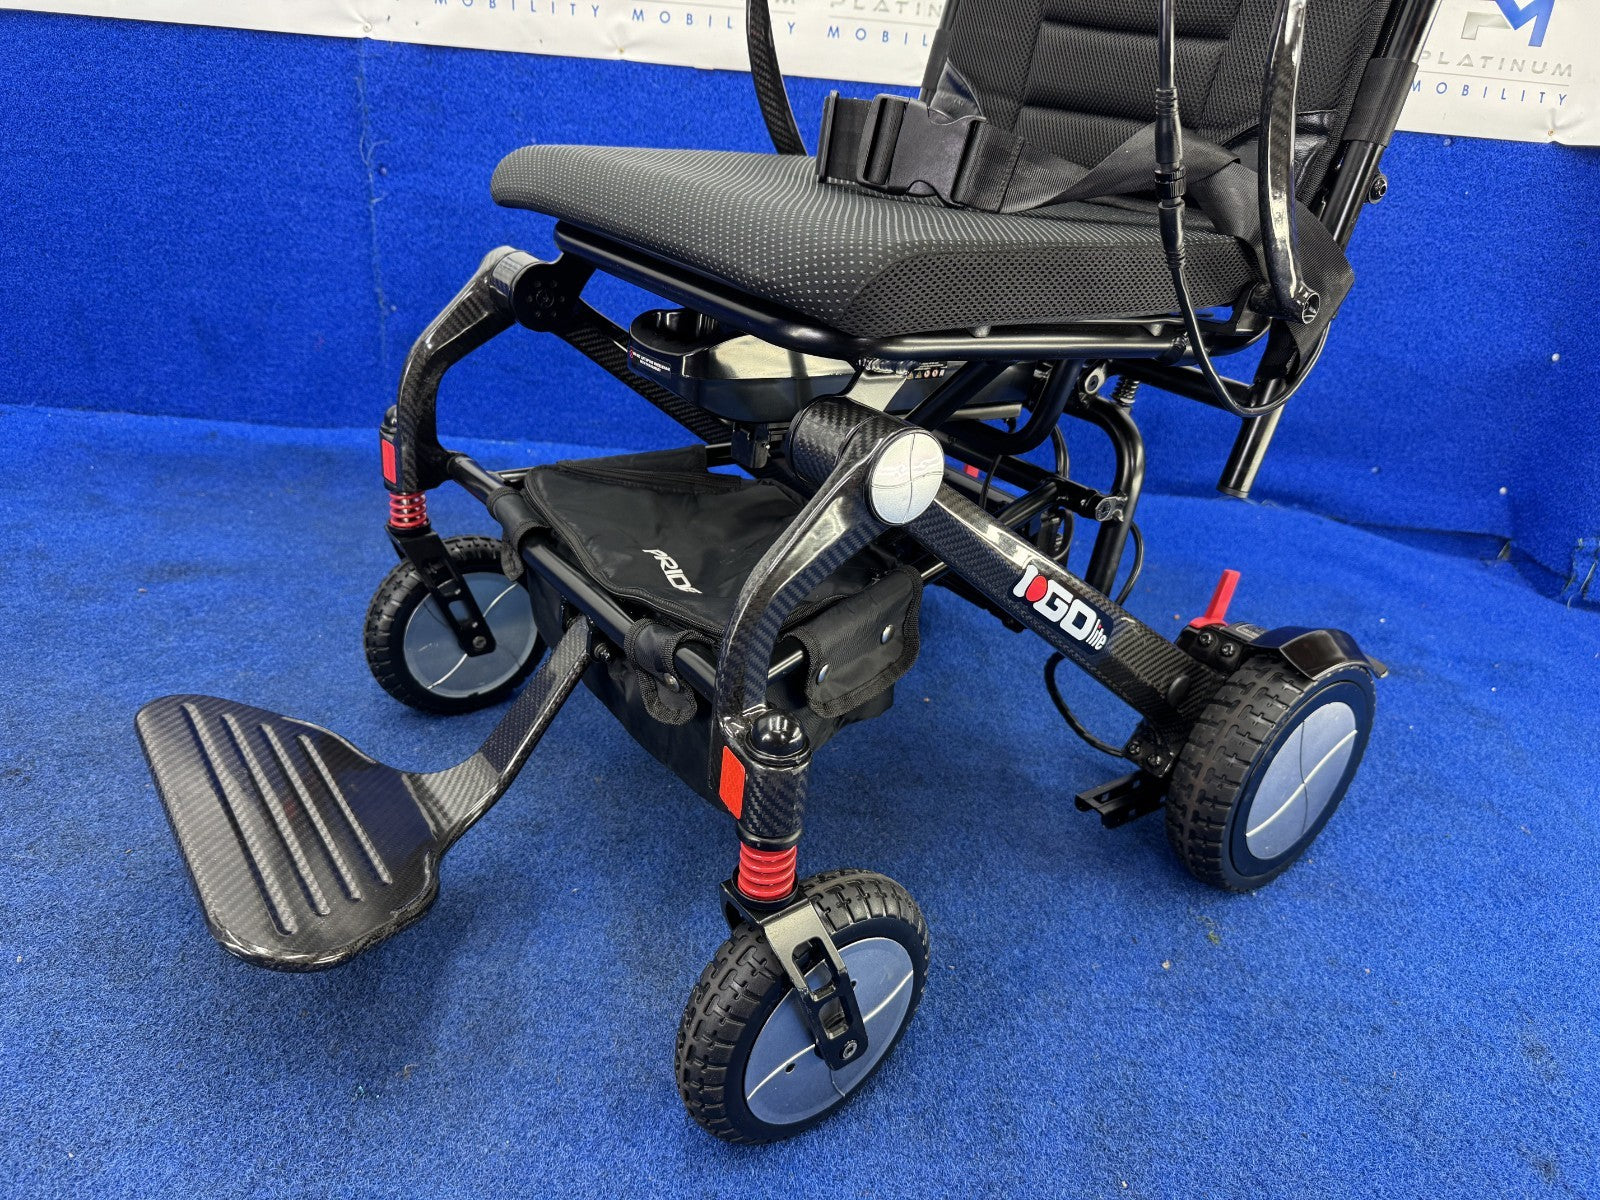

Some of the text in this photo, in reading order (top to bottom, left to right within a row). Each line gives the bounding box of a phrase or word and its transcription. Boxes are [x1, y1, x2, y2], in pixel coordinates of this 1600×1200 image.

[631, 8, 796, 35] MOBILY
[827, 25, 928, 47] MOBIL
[1410, 79, 1568, 106] MOBILITY
[1085, 618, 1108, 651] lite
